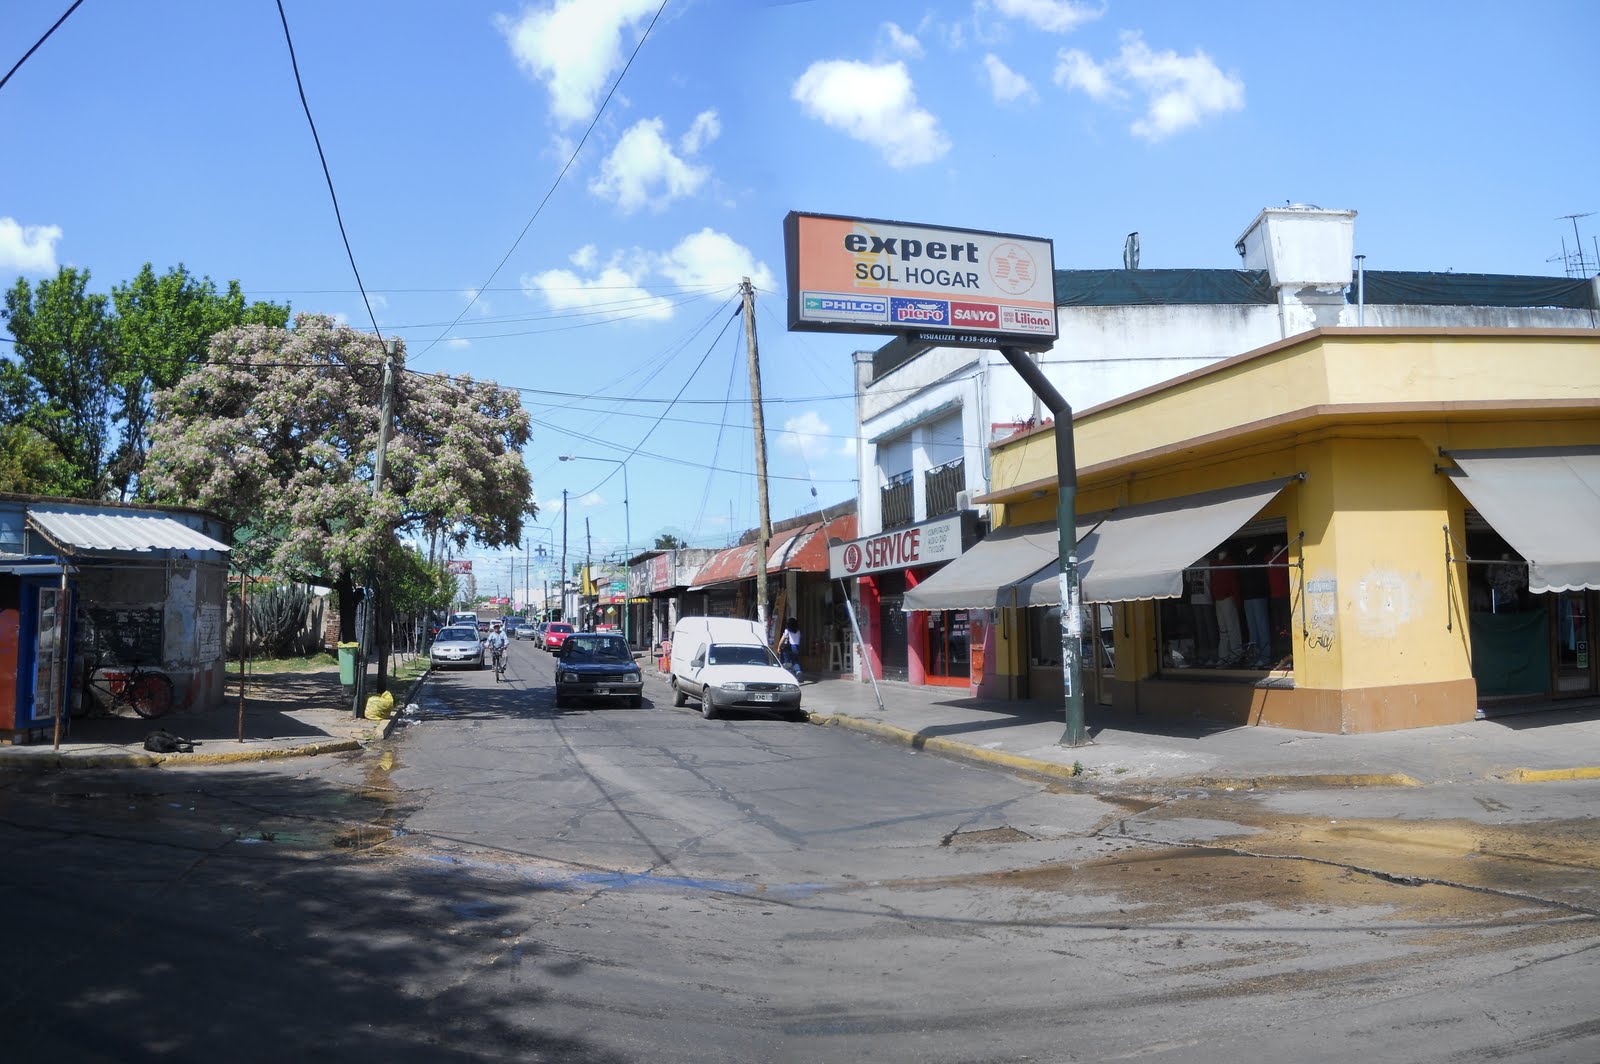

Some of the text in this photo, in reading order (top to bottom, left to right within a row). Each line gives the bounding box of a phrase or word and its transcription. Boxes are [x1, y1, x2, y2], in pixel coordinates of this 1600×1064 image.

[844, 233, 979, 263] expert
[855, 263, 980, 289] SOL HOGAR
[821, 300, 885, 312] PHILCO
[897, 304, 944, 322] piero
[953, 308, 996, 322] SANYO
[1015, 311, 1050, 326] Liliana
[919, 333, 997, 344] VISUALIZER 4238-6666
[865, 528, 921, 568] SERVICE
